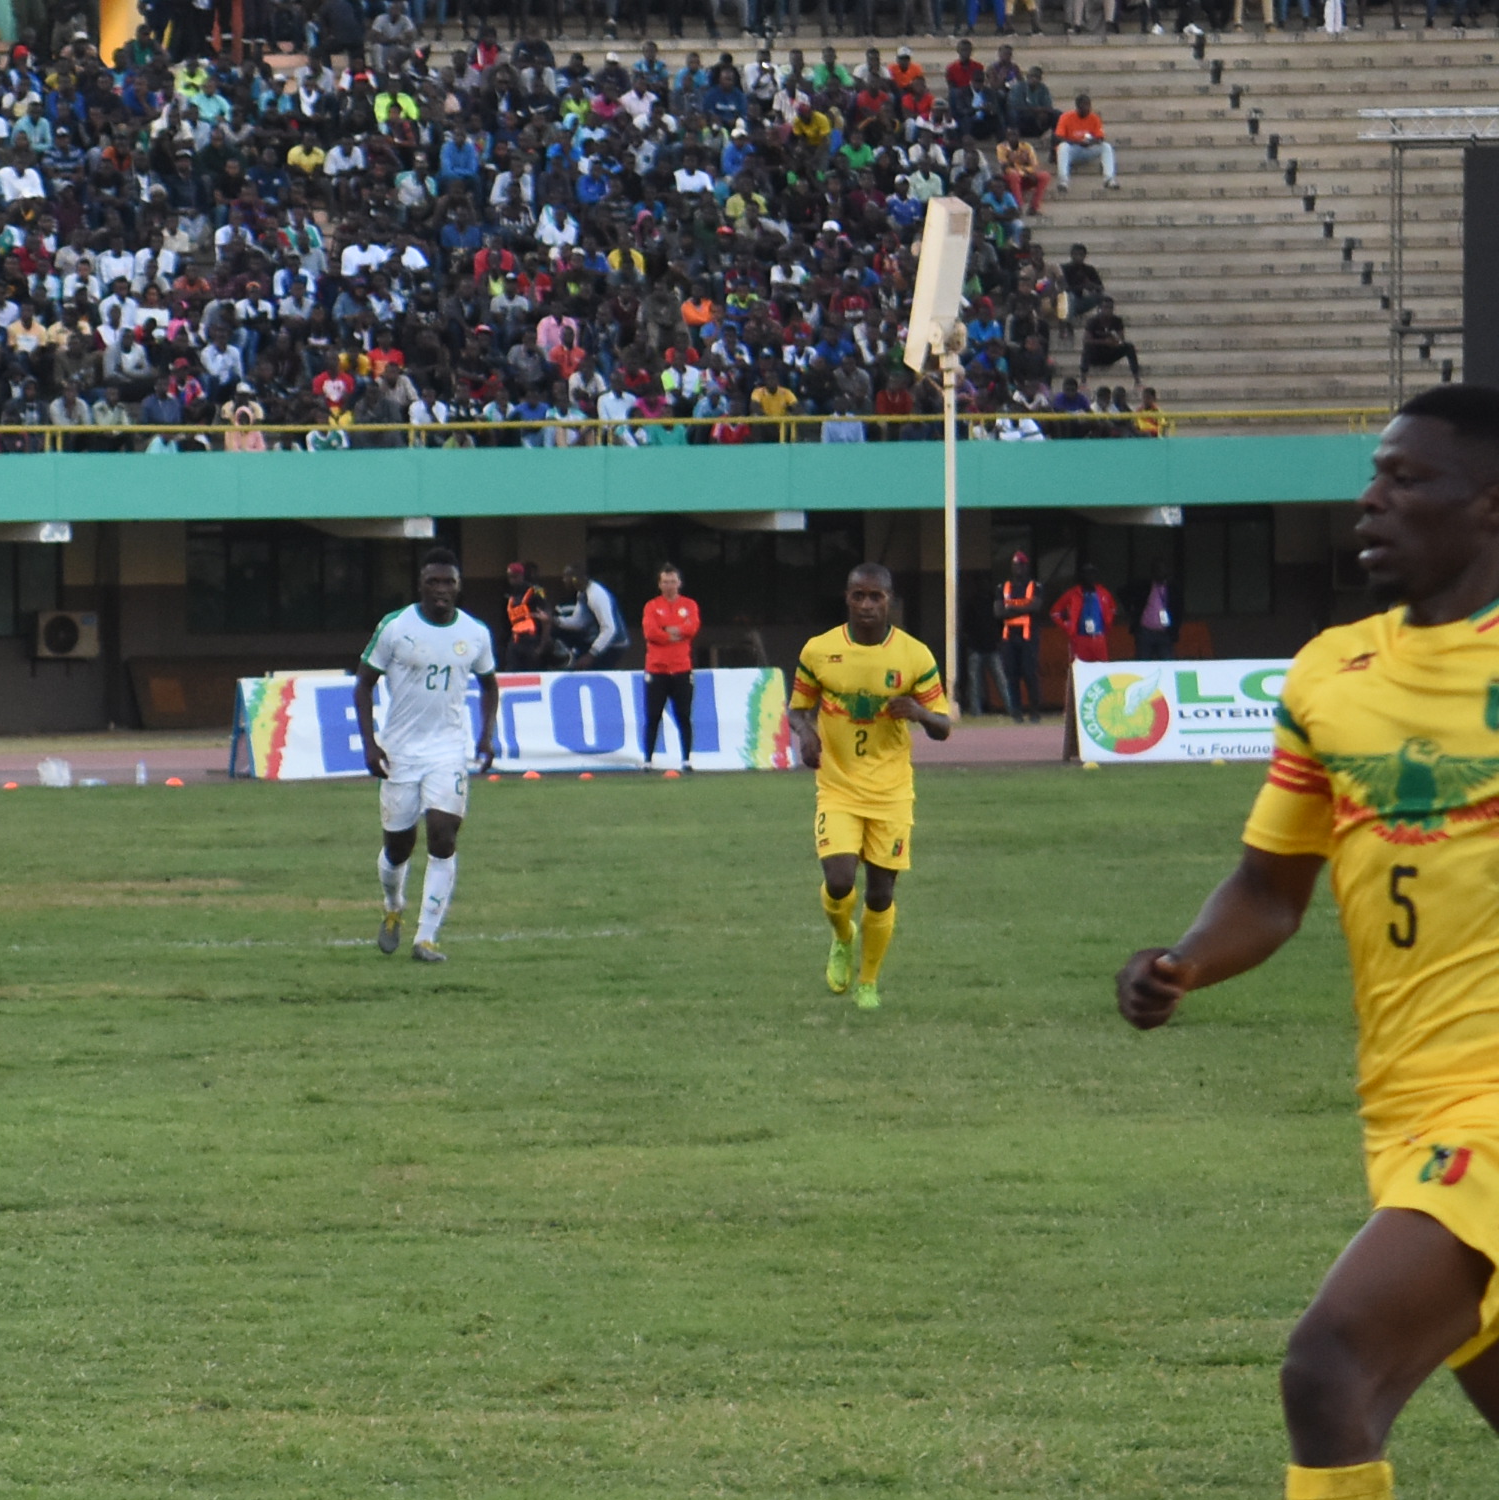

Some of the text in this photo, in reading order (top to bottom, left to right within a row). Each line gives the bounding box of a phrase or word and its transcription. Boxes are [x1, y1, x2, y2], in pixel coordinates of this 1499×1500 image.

[425, 664, 452, 692] 21
[855, 729, 868, 757] 2
[817, 812, 826, 835] 2
[1388, 864, 1418, 949] 5
